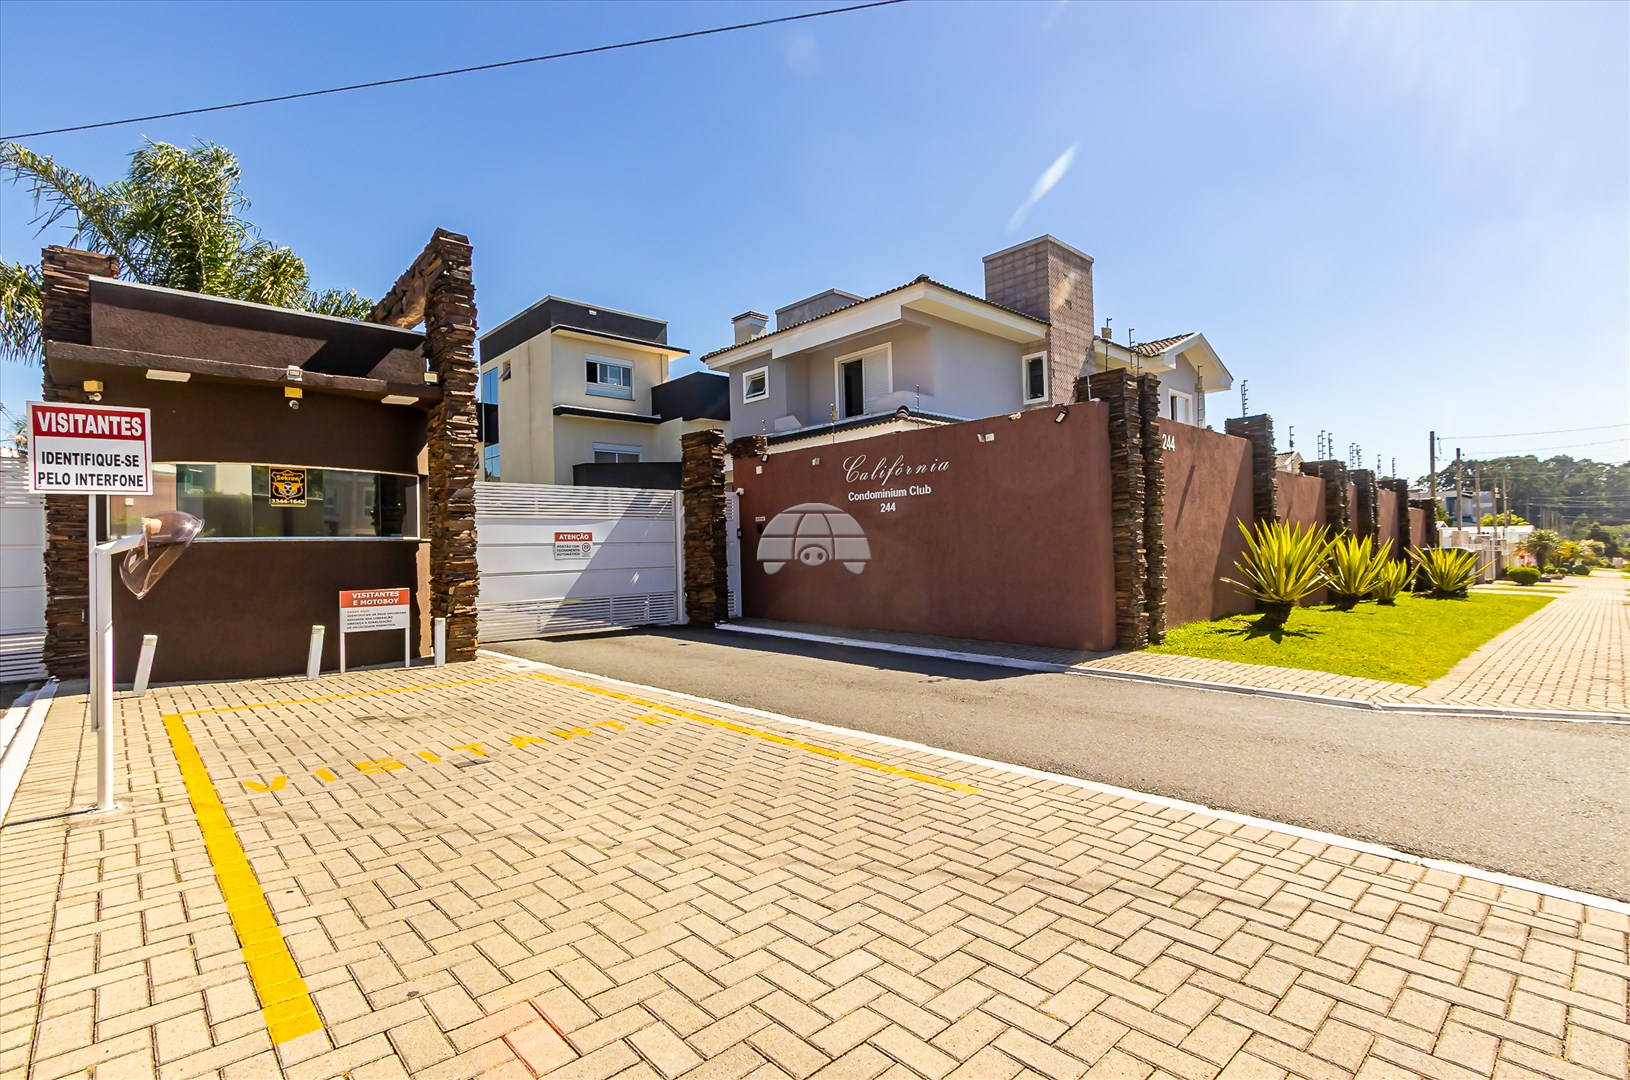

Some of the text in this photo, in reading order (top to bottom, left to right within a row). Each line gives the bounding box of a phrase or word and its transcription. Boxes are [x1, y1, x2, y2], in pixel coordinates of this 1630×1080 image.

[37, 411, 142, 437] VISITANTES
[1162, 433, 1176, 451] 244
[41, 451, 140, 468] IDENTIFIQUE-SE
[843, 454, 950, 486] Califórnia
[38, 471, 144, 487] PELO INTERFONE
[848, 484, 932, 501] Condominium Club
[880, 502, 896, 513] 244
[559, 532, 590, 541] ATENÇÃO
[352, 591, 400, 599] VISITANTES
[242, 712, 676, 793] VISITANTE
